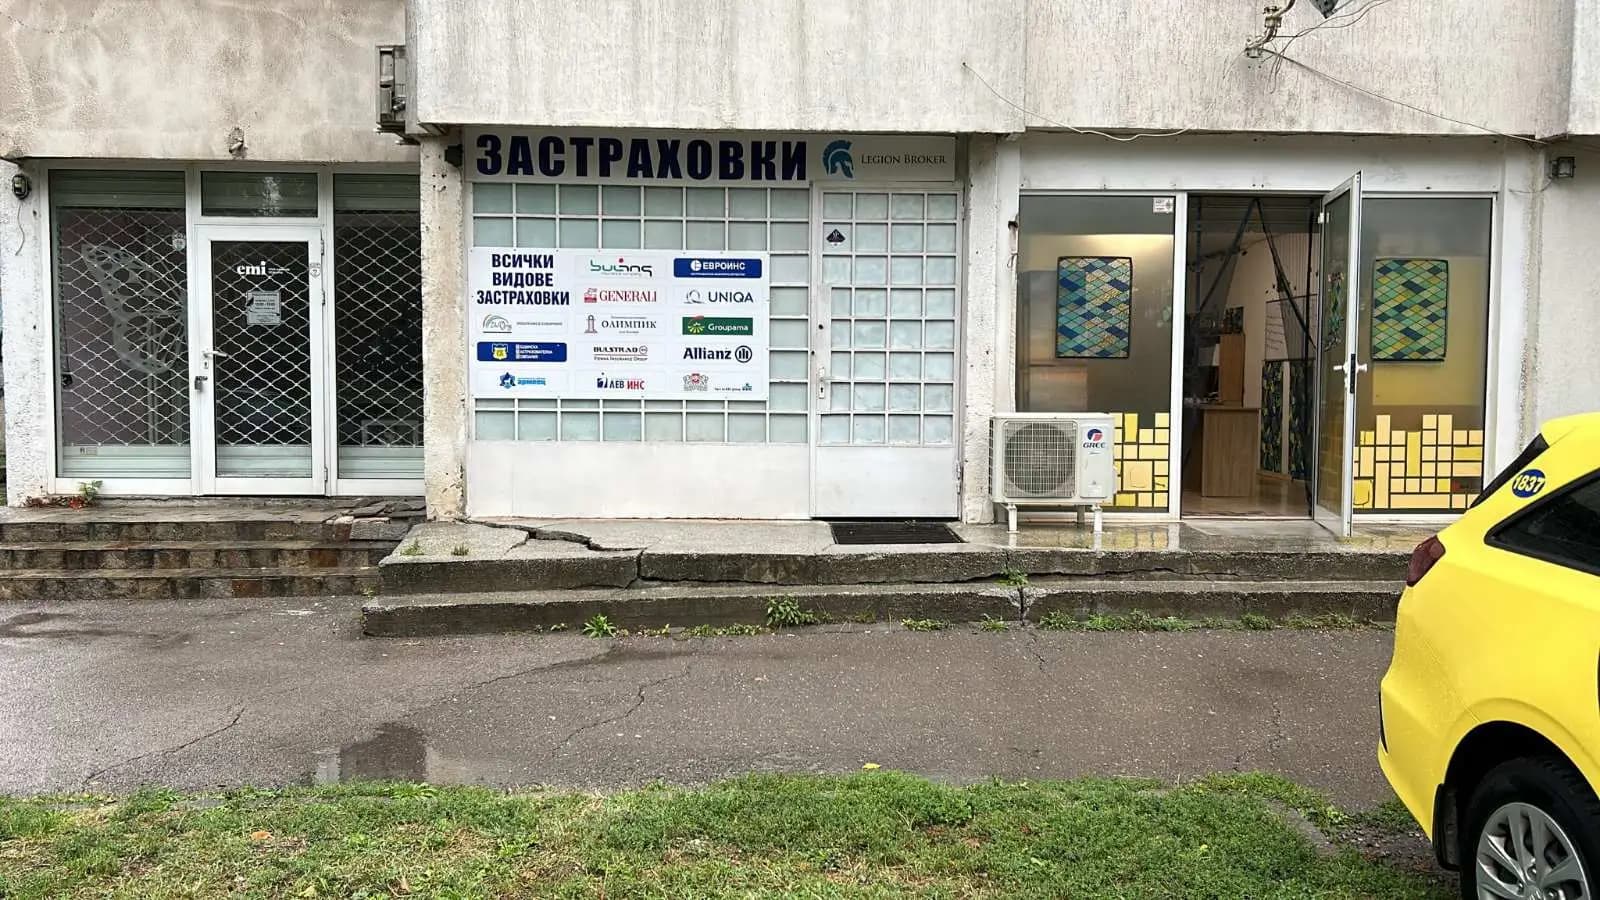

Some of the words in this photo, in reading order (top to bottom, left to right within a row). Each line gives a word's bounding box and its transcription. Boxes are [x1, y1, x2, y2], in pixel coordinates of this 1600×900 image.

[476, 134, 807, 181] ЗАСТРАХОВКИ
[236, 260, 266, 275] emi
[491, 253, 554, 269] ВСИЧКИ
[702, 261, 746, 271] ЕВРОИНС
[492, 272, 554, 288] ВИДОВЕ
[476, 289, 570, 306] ЗАСТРАХОВКИ
[599, 290, 657, 303] GENERALI
[708, 291, 754, 303] UNIQA
[601, 319, 657, 329] ОЛИМПИК
[707, 323, 749, 332] Groupama
[683, 347, 732, 360] Allianz
[609, 380, 625, 389] ЛЕВ
[627, 380, 645, 390] ИНС
[1513, 474, 1545, 493] 1837
